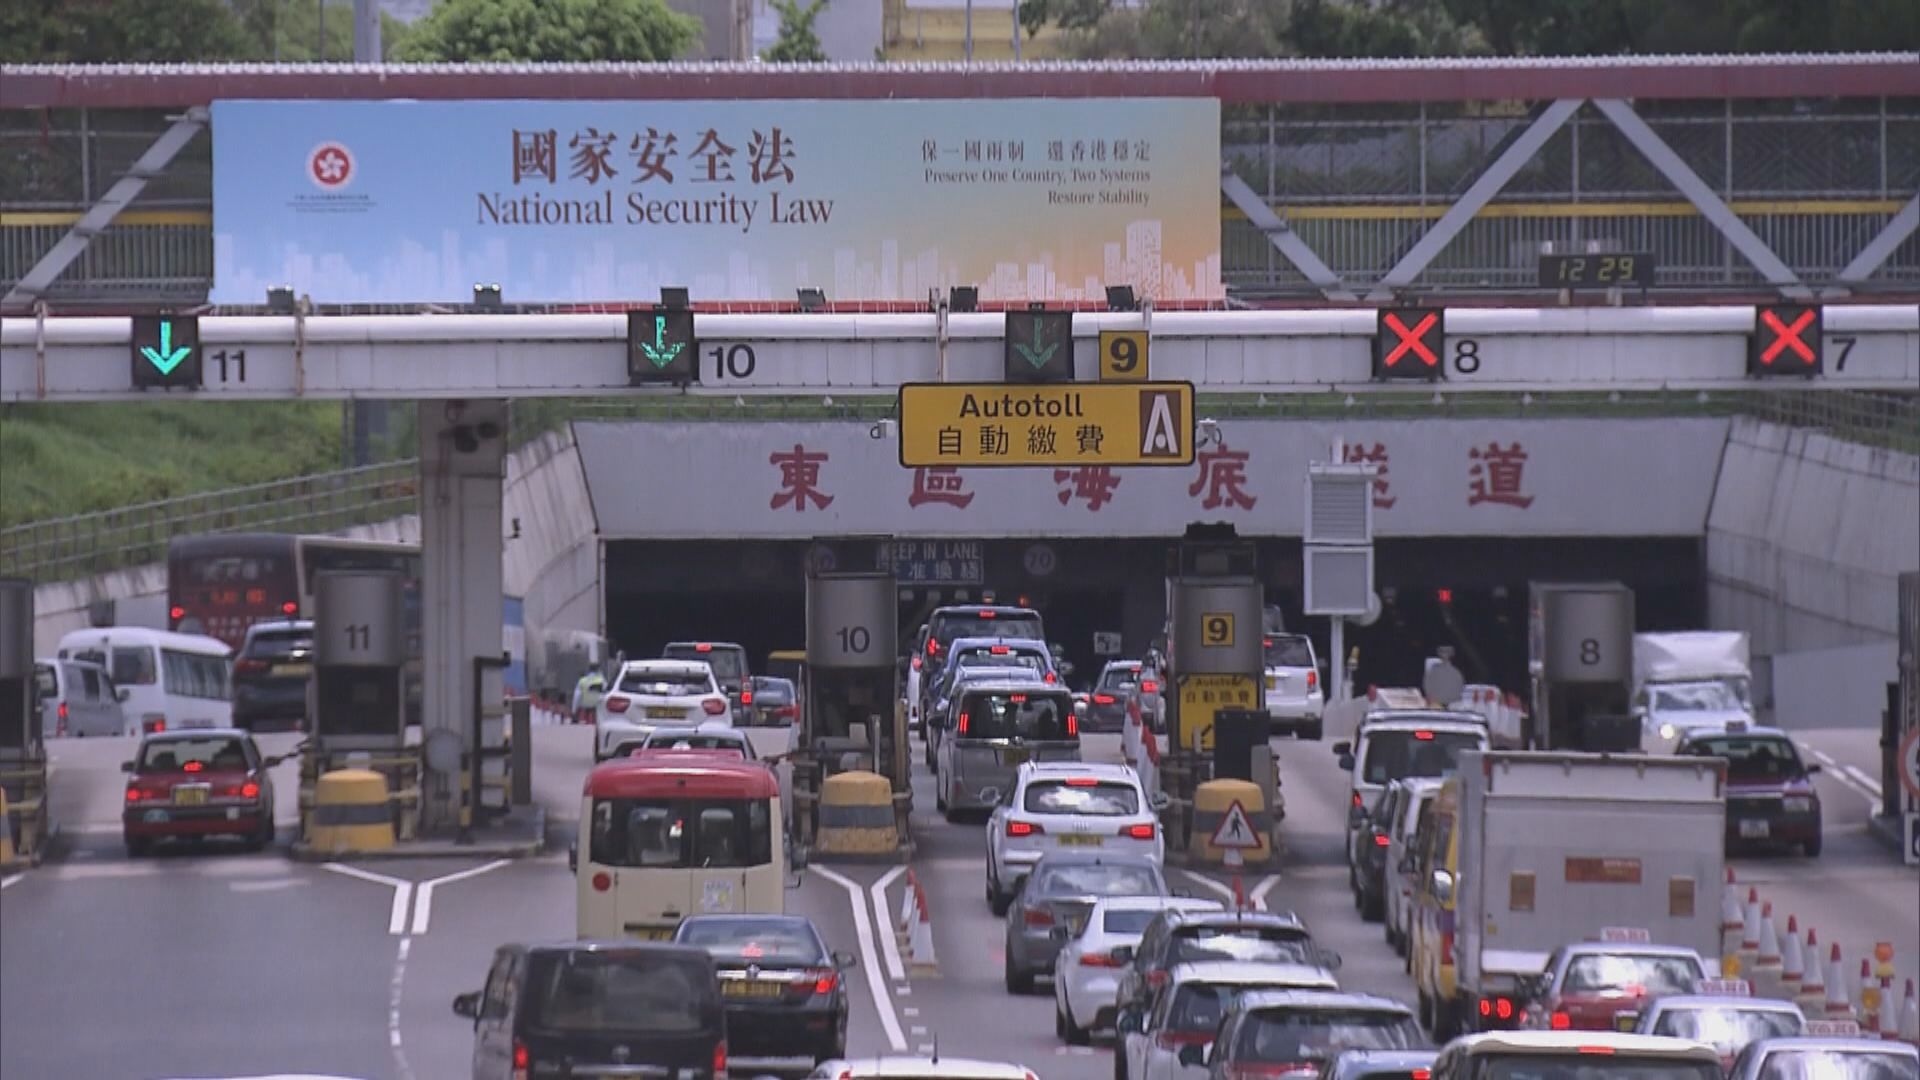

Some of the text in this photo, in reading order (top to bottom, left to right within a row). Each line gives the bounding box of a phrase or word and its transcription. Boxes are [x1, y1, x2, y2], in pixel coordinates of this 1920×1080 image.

[511, 127, 797, 185] 國家安全法
[922, 139, 1151, 162] 保一國兩制 還香港穩定
[924, 168, 1151, 185] Preserve One Country, Two Systems
[476, 190, 835, 233] National Security Law
[1048, 189, 1151, 207] Restore Stability
[1558, 257, 1635, 281] 12 29
[211, 350, 247, 384] 11
[708, 343, 756, 380] 10
[1108, 338, 1139, 374] 9
[1454, 339, 1481, 374] 8
[1831, 337, 1857, 372] 7
[959, 393, 1085, 419] Autotoll
[937, 424, 1104, 456] 自動繳費
[922, 542, 937, 560] IN
[944, 542, 981, 560] LANE
[344, 624, 371, 651] 11
[835, 626, 871, 654] 10
[1207, 616, 1228, 642] 9
[1579, 638, 1601, 667] 8
